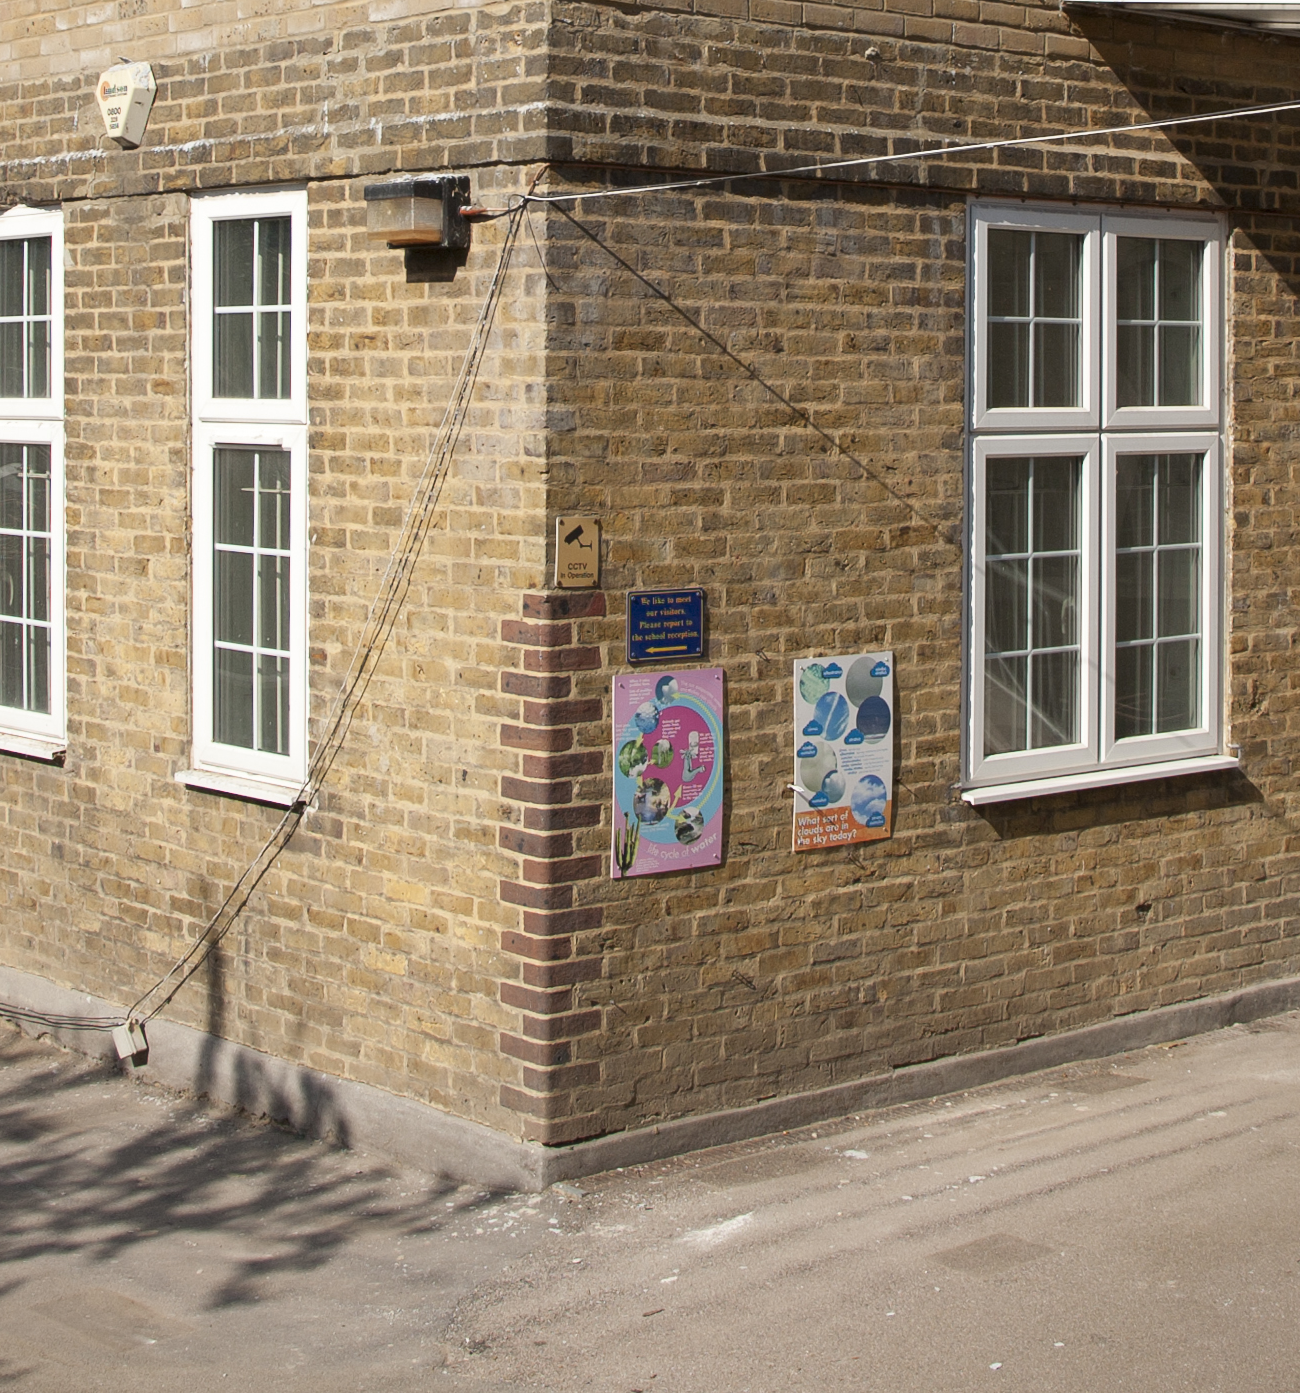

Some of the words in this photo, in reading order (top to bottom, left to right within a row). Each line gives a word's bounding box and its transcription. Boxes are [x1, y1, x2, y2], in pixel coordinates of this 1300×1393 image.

[567, 562, 588, 570] CCTV
[567, 571, 594, 579] Operation
[652, 596, 665, 604] like
[675, 595, 691, 603] meet
[659, 607, 686, 615] visitors.
[639, 621, 661, 629] Please
[663, 619, 684, 628] report
[631, 633, 643, 641] the
[645, 631, 666, 640] school
[797, 815, 820, 826] What
[822, 813, 838, 824] sort
[840, 810, 848, 821] of
[797, 824, 824, 836] clouds
[825, 824, 839, 833] are
[841, 820, 849, 830] in
[797, 835, 810, 846] the
[812, 833, 827, 845] sky
[829, 828, 857, 841] today?
[647, 843, 659, 857] life
[660, 848, 680, 861] cycle
[681, 845, 690, 857] of
[690, 832, 717, 854] water
